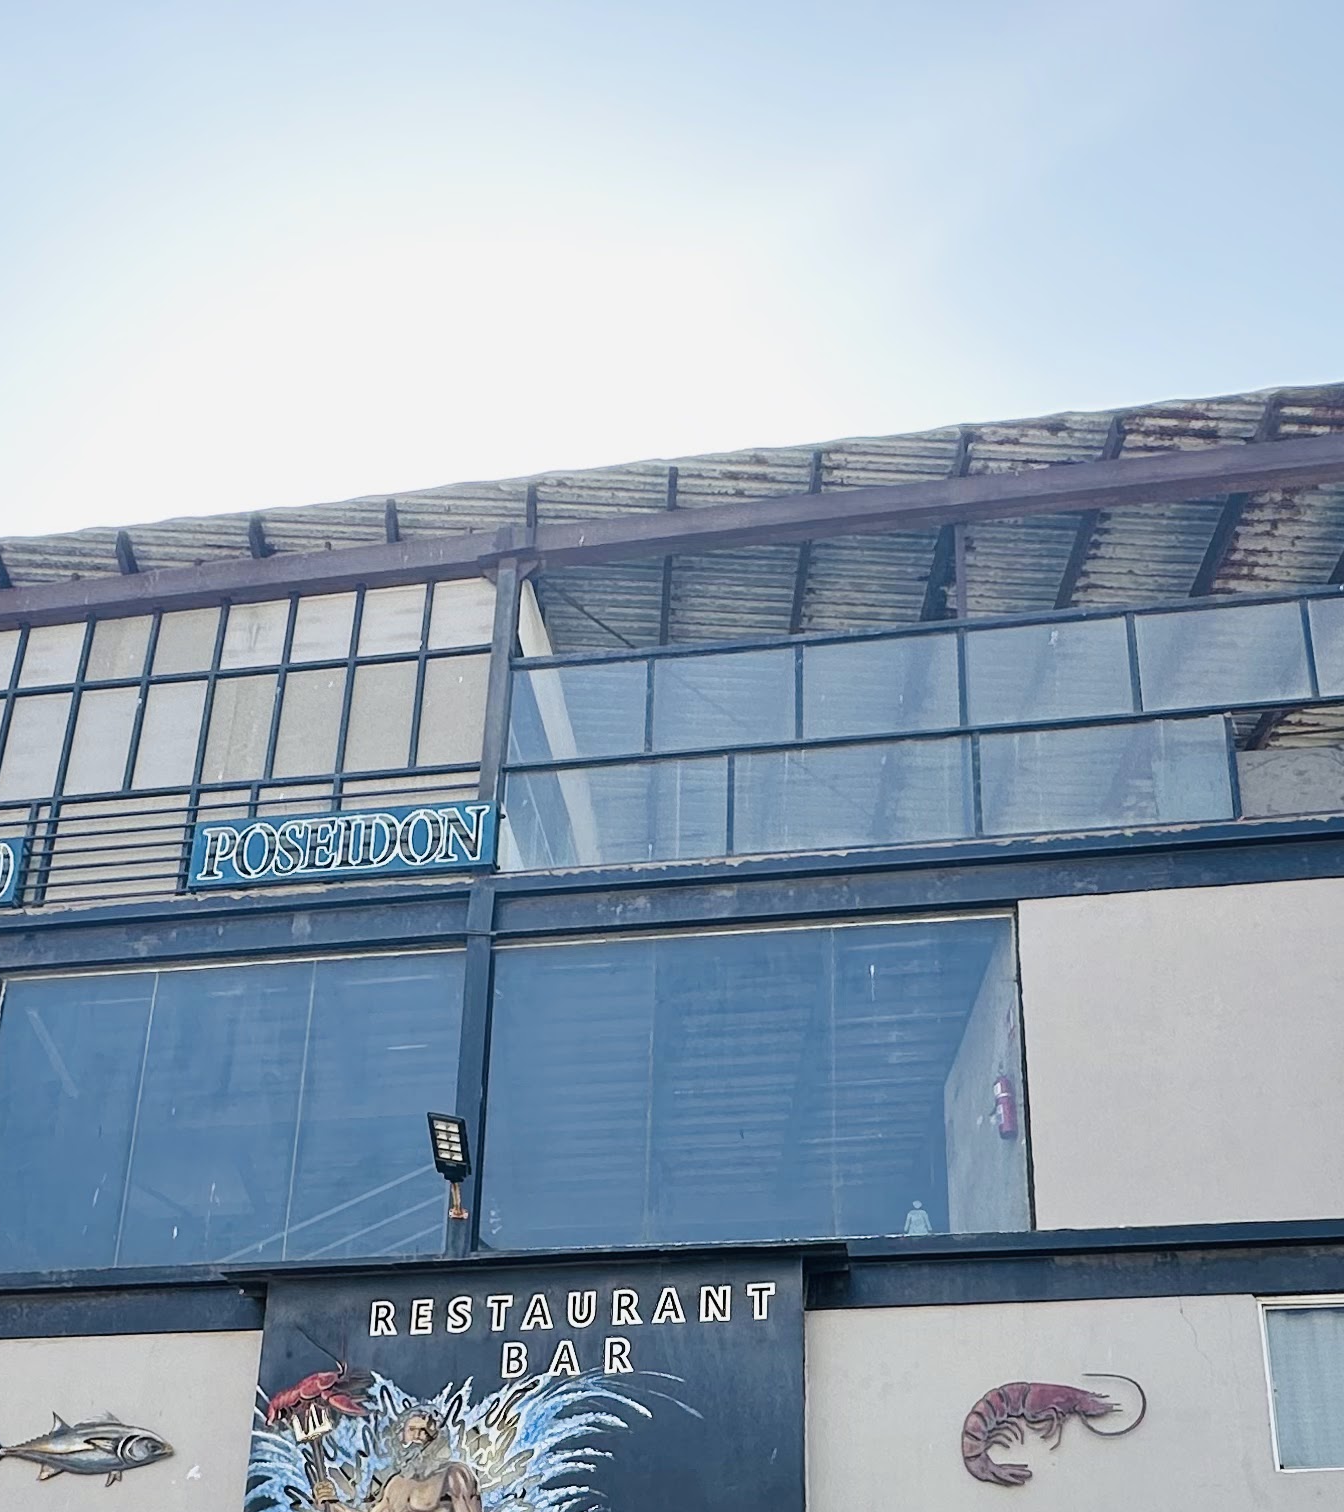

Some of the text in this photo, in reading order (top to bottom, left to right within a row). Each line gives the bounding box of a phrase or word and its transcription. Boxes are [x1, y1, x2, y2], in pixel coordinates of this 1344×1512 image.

[199, 803, 492, 882] POSEIDON
[369, 1282, 776, 1336] RESTAURANT
[501, 1337, 634, 1379] BAR
